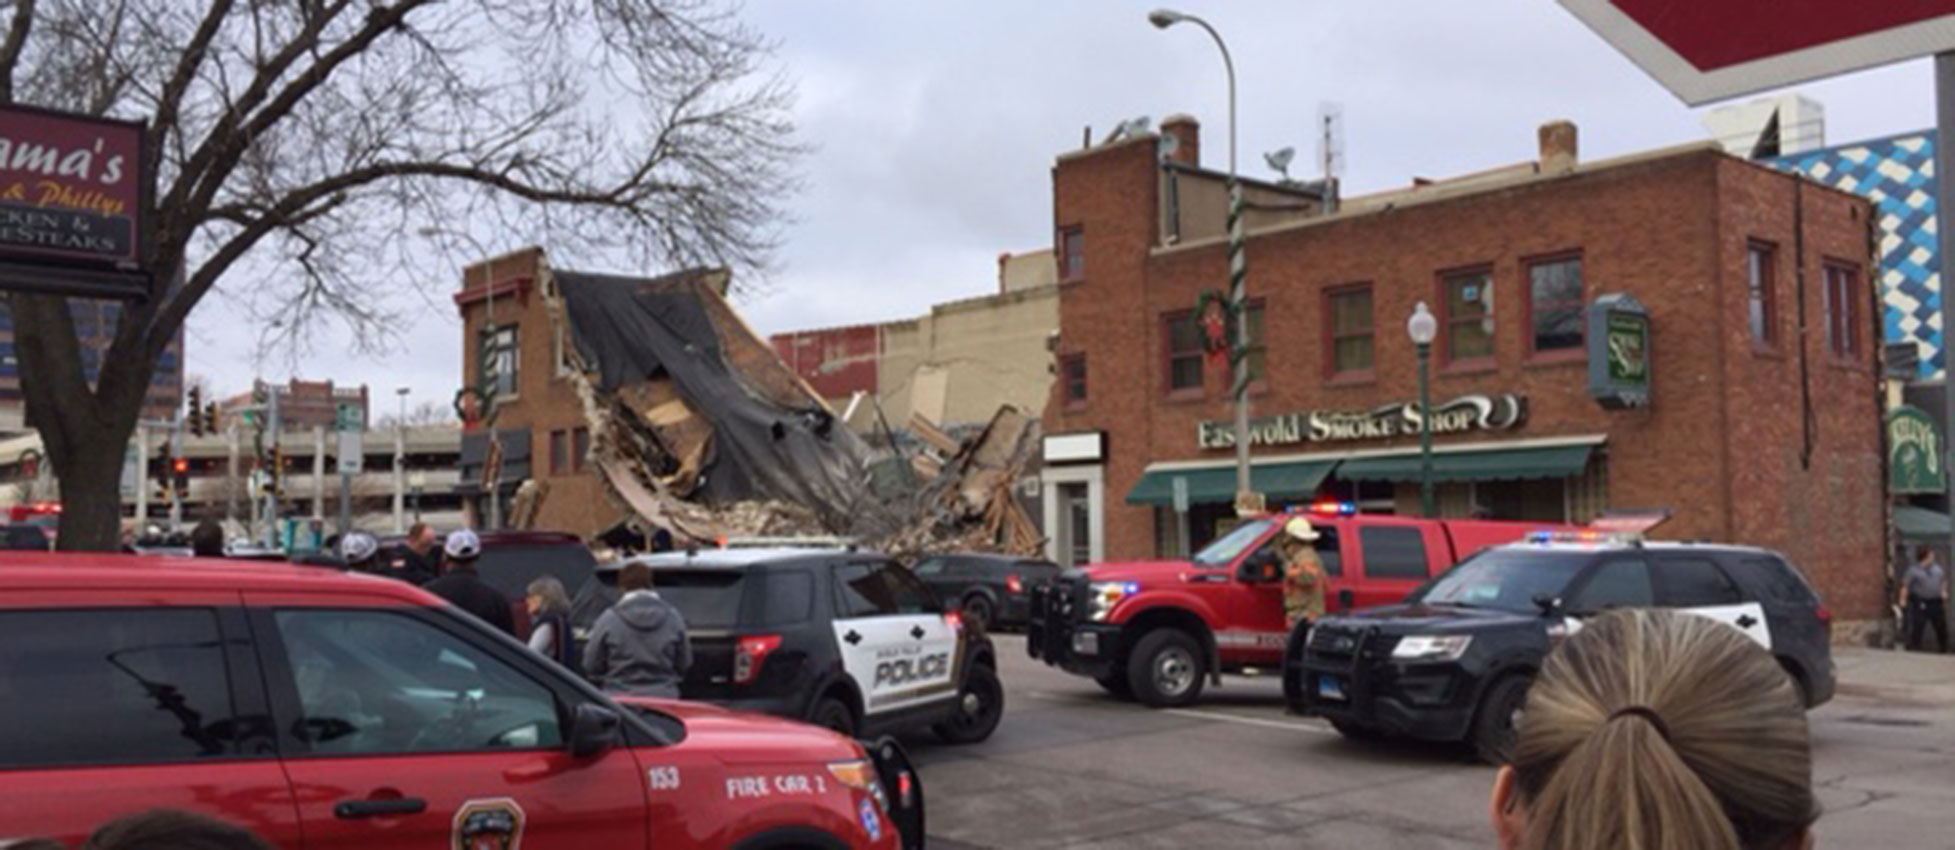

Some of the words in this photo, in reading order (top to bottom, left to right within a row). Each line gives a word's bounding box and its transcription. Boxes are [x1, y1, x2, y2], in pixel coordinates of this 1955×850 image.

[3, 182, 25, 199] &
[1199, 414, 1299, 448] Easwold
[874, 652, 948, 689] POLICE
[649, 766, 679, 789] 153
[726, 777, 770, 799] FIRE
[774, 776, 812, 794] CAR
